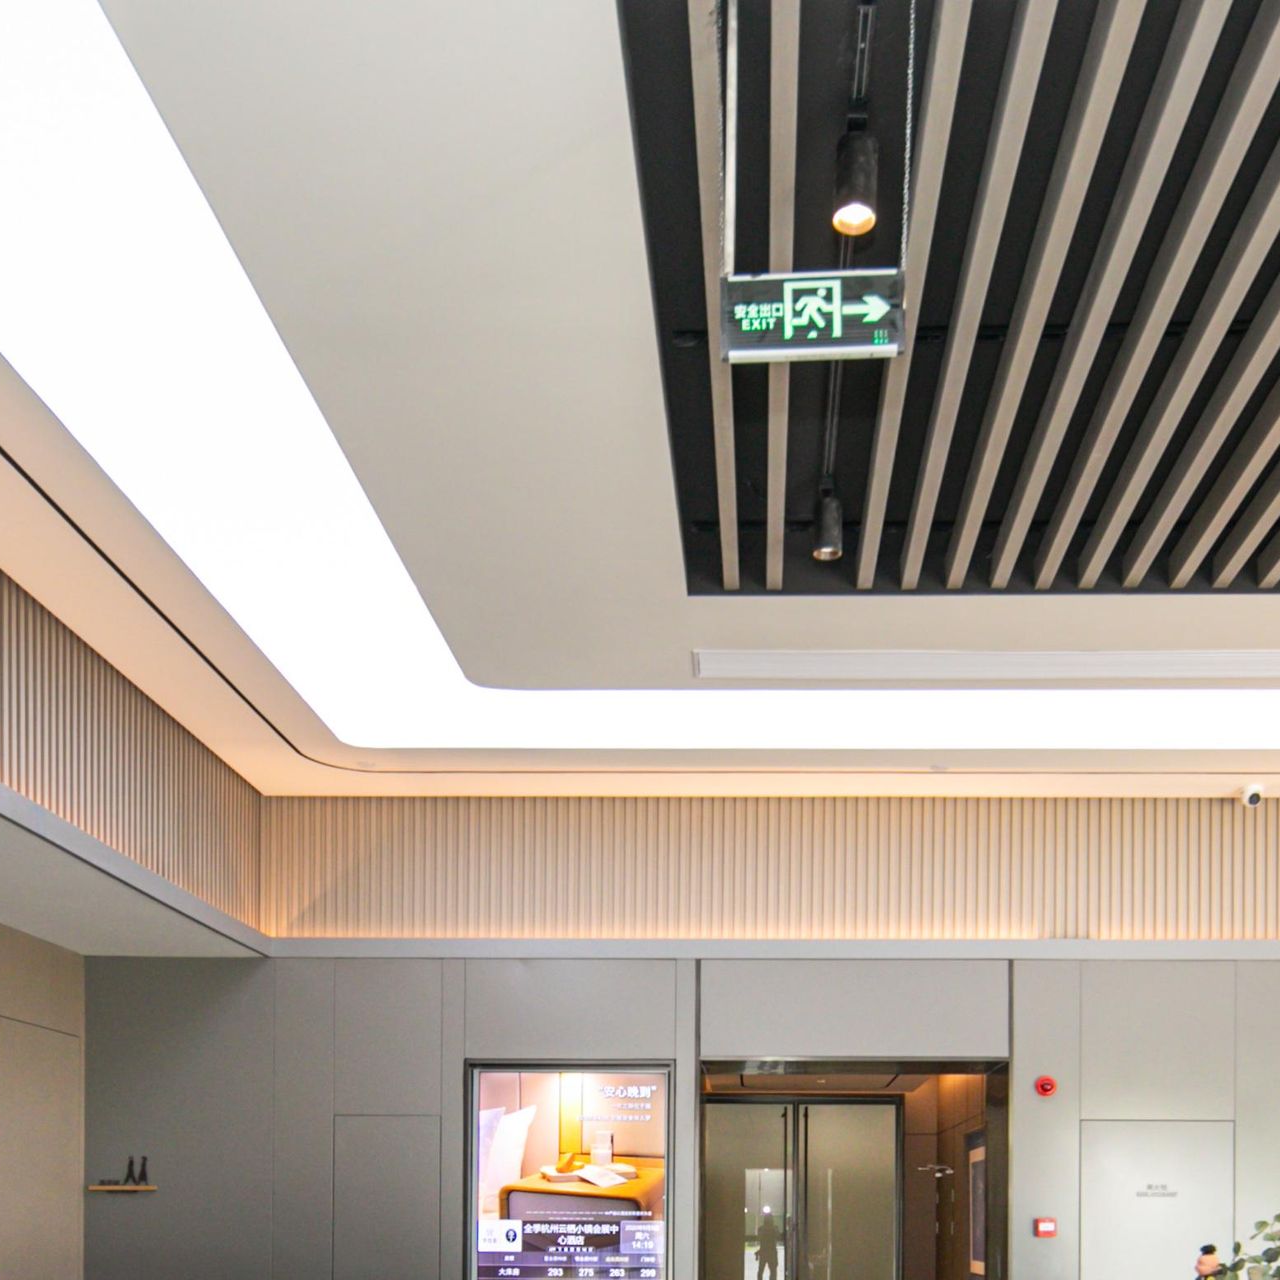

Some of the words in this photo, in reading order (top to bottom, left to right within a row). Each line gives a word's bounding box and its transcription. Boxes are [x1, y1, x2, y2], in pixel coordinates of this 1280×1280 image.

[734, 303, 783, 318] 安全出口
[741, 318, 777, 331] EXIT
[557, 1235, 585, 1246] 心酒店
[498, 1268, 520, 1276] 大床房
